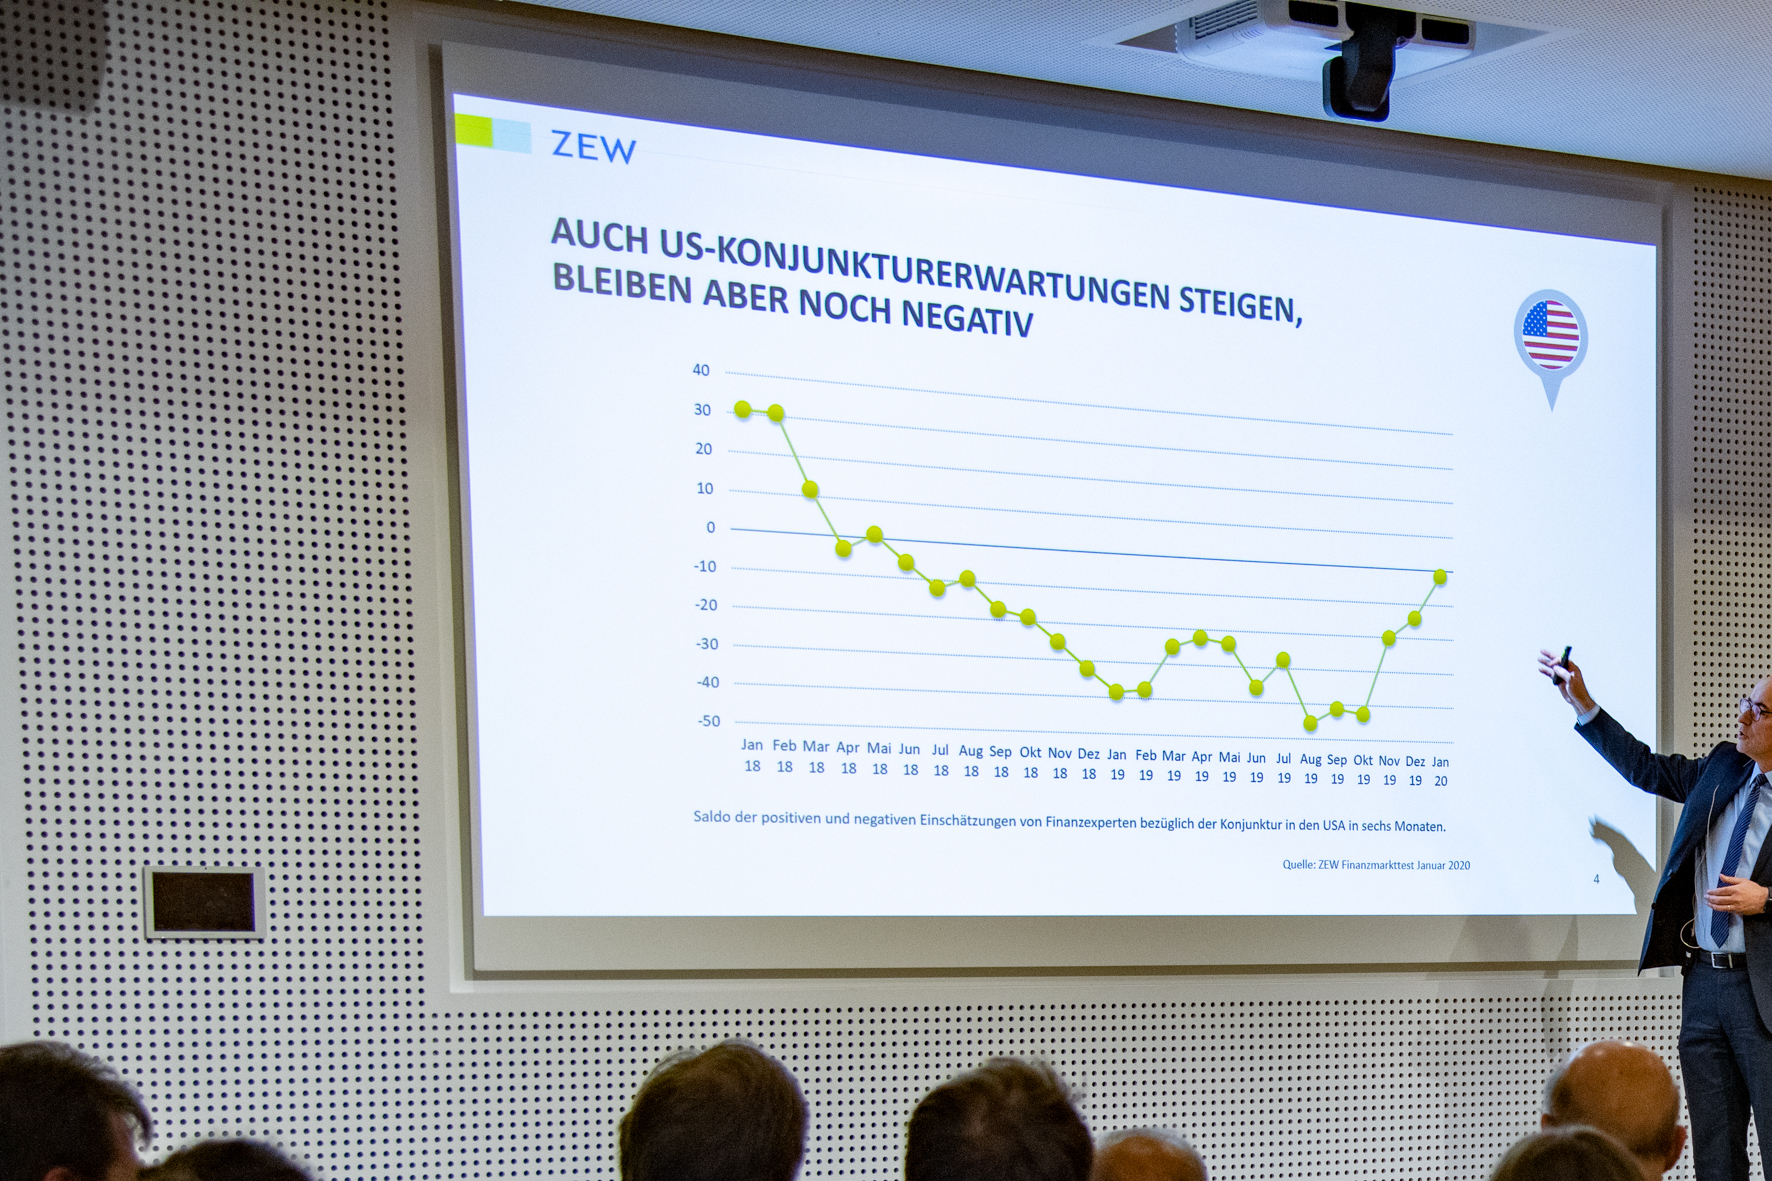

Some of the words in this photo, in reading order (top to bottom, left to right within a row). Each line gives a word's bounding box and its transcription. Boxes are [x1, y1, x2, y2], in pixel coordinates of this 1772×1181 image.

[551, 129, 637, 165] ZEW
[551, 216, 649, 255] AUCH
[660, 228, 1171, 311] US-KONJUNKTURERWARTUNGEN
[1179, 286, 1305, 329] STEIGEN,
[552, 261, 693, 305] BLEIBEN
[703, 279, 789, 315] ABER
[798, 288, 892, 325] NOCH
[902, 298, 1034, 339] NEGATIV
[692, 363, 710, 377] 40
[694, 402, 711, 416] 30
[695, 442, 712, 455] 20
[697, 481, 714, 495] 10
[706, 521, 716, 534] 0
[694, 560, 717, 573] -10
[695, 598, 718, 611] -20
[696, 637, 719, 650] -30
[697, 676, 720, 688] -40
[698, 714, 721, 727] -50
[741, 738, 763, 750] Jan
[773, 739, 797, 752] Feb
[803, 740, 830, 752] Mar
[836, 741, 860, 756] Apr
[867, 742, 892, 754] Mai
[898, 743, 920, 755] Jun
[932, 743, 949, 756] Jul
[958, 744, 984, 760] Aug
[989, 745, 1012, 760] Sep
[1019, 746, 1042, 758] Okt
[1048, 747, 1072, 759] Nov
[1078, 747, 1100, 760] Dez
[1107, 748, 1127, 760] Jan
[1135, 749, 1157, 761] Feb
[1162, 750, 1186, 762] Mar
[1191, 750, 1213, 765] Apr
[1219, 751, 1241, 763] Mai
[1247, 752, 1266, 763] Jun
[1276, 752, 1291, 764] Jul
[1300, 753, 1322, 767] Aug
[1327, 753, 1348, 768] Sep
[1353, 754, 1373, 766] Okt
[1379, 755, 1400, 766] Nov
[1406, 755, 1426, 767] Dez
[1432, 756, 1449, 767] Jan
[745, 760, 761, 772] 18
[777, 760, 793, 773] 18
[809, 761, 825, 774] 18
[841, 762, 857, 774] 18
[873, 763, 888, 775] 18
[903, 763, 919, 776] 18
[934, 764, 949, 777] 18
[964, 765, 979, 777] 18
[994, 766, 1009, 778] 18
[1024, 766, 1038, 779] 18
[1053, 767, 1068, 779] 18
[1082, 768, 1097, 780] 18
[1111, 768, 1125, 780] 19
[1139, 769, 1153, 781] 19
[1167, 770, 1181, 782] 19
[1195, 770, 1209, 782] 19
[1223, 771, 1237, 783] 19
[1250, 771, 1264, 783] 19
[1278, 772, 1291, 784] 19
[1305, 773, 1318, 784] 19
[1331, 773, 1344, 785] 19
[1357, 774, 1371, 785] 19
[1384, 774, 1397, 786] 19
[1409, 775, 1422, 786] 19
[1434, 775, 1448, 787] 20
[693, 810, 731, 823] Saldo
[735, 810, 758, 823] der
[761, 811, 821, 826] positiven
[825, 812, 850, 824] und
[854, 813, 916, 828] negativen
[920, 813, 1016, 829] Einschätzungen
[1019, 818, 1042, 827] von
[1046, 815, 1137, 830] Finanzexperten
[1140, 816, 1194, 832] bezüglich
[1197, 817, 1217, 829] der
[1220, 818, 1283, 832] Konjunktur
[1285, 819, 1296, 830] in
[1298, 819, 1320, 831] den
[1323, 819, 1346, 831] USA
[1348, 820, 1359, 831] in
[1361, 820, 1392, 831] sechs
[1394, 820, 1446, 832] Monaten.
[1282, 859, 1316, 870] Quelle:
[1318, 859, 1339, 869] ZEW
[1342, 859, 1414, 870] Finanzmarkttest
[1417, 861, 1446, 870] Januar
[1448, 860, 1471, 870] 2020
[1593, 874, 1600, 884] 4
